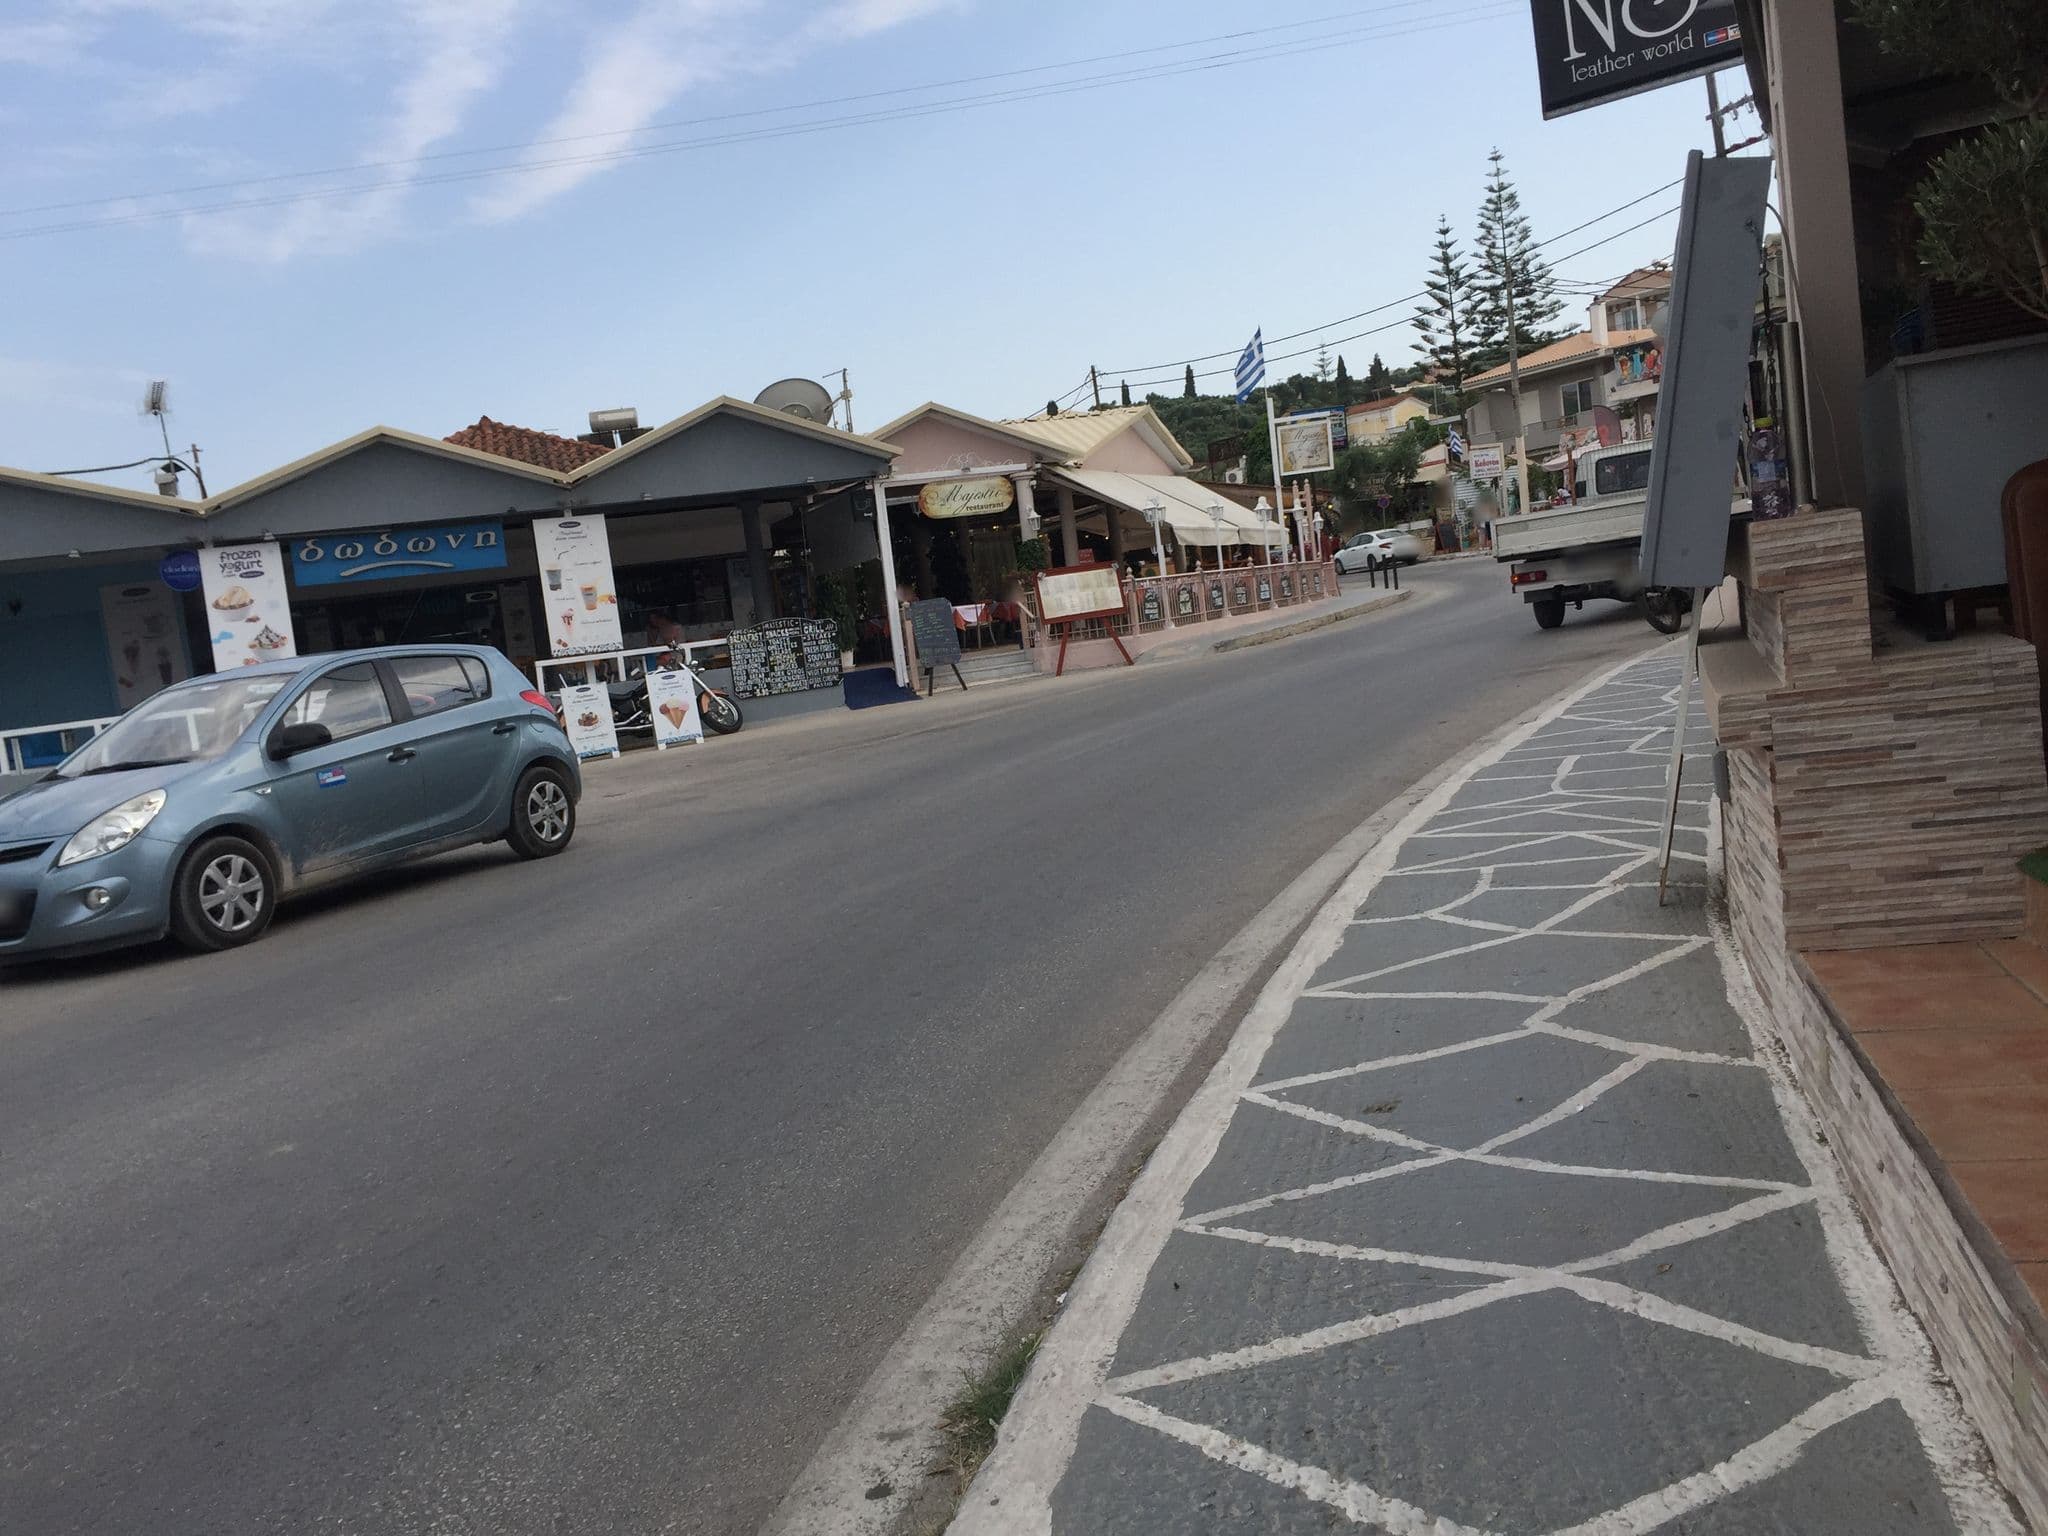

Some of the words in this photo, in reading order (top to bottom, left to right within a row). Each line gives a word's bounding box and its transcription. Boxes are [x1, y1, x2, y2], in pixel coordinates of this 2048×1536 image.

[1570, 52, 1635, 83] leather
[1641, 28, 1694, 62] world
[965, 502, 1004, 512] restaurant
[220, 549, 261, 563] frozen
[219, 559, 263, 574] yogurt
